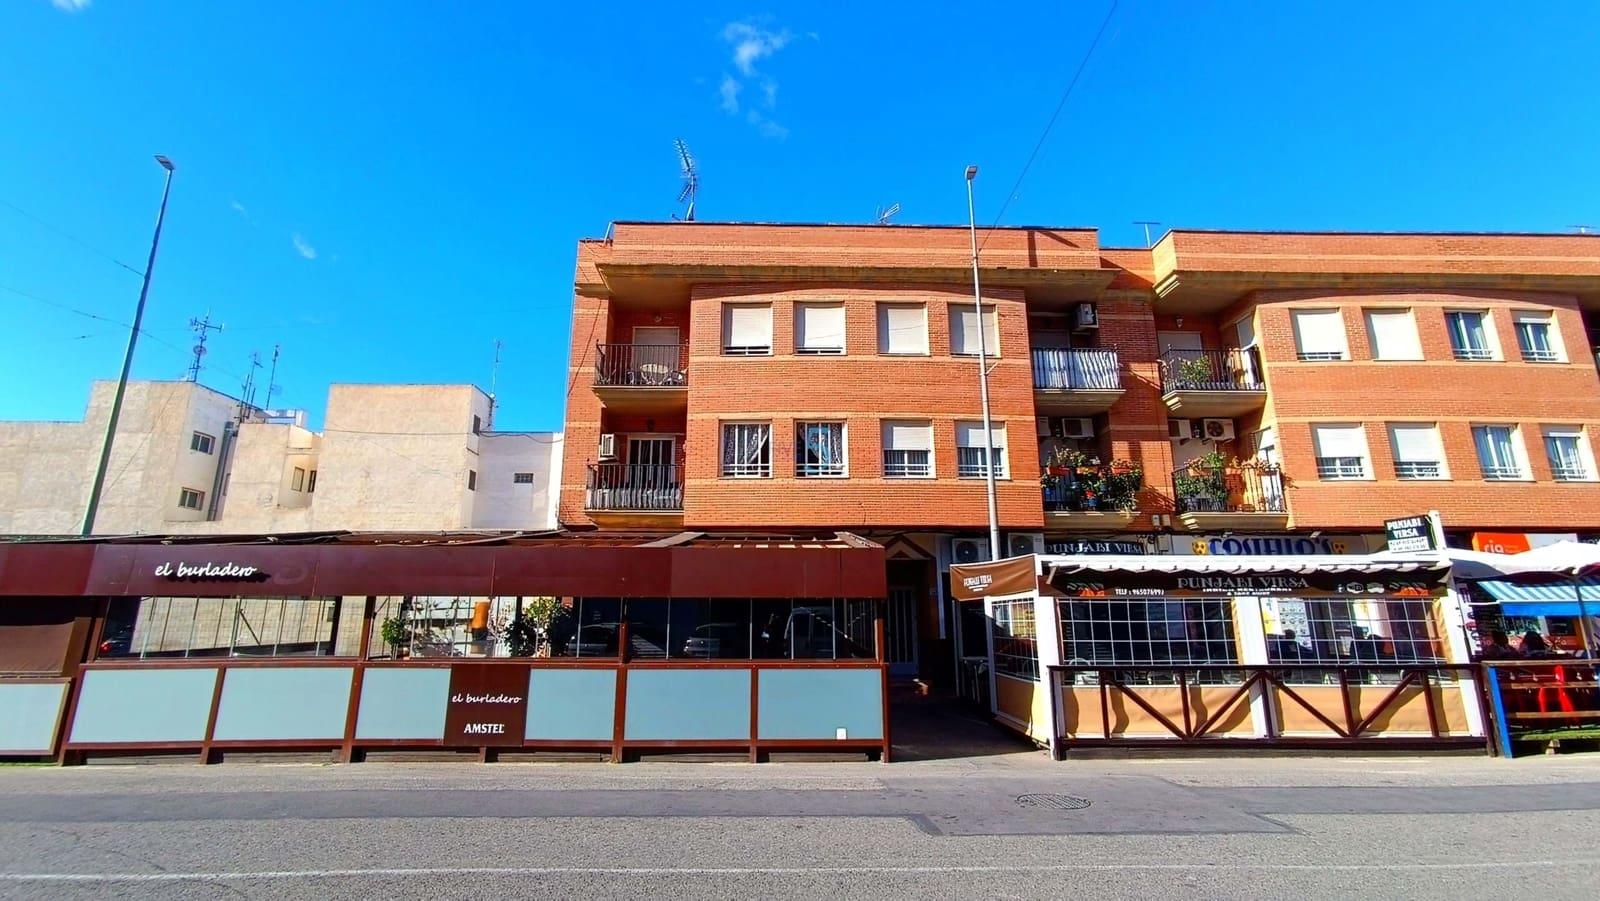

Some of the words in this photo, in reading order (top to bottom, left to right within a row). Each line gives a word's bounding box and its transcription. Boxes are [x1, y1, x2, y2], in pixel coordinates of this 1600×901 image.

[1387, 518, 1421, 530] PUNJABI
[1392, 528, 1419, 538] VIRSA
[1484, 540, 1504, 553] ria
[155, 562, 173, 576] el
[177, 562, 257, 577] burladero
[1177, 578, 1254, 588] PUNJABI
[1258, 577, 1310, 588] VIRSA
[452, 693, 464, 702] el
[466, 693, 522, 704] burladero
[463, 723, 505, 734] AMSTEL
